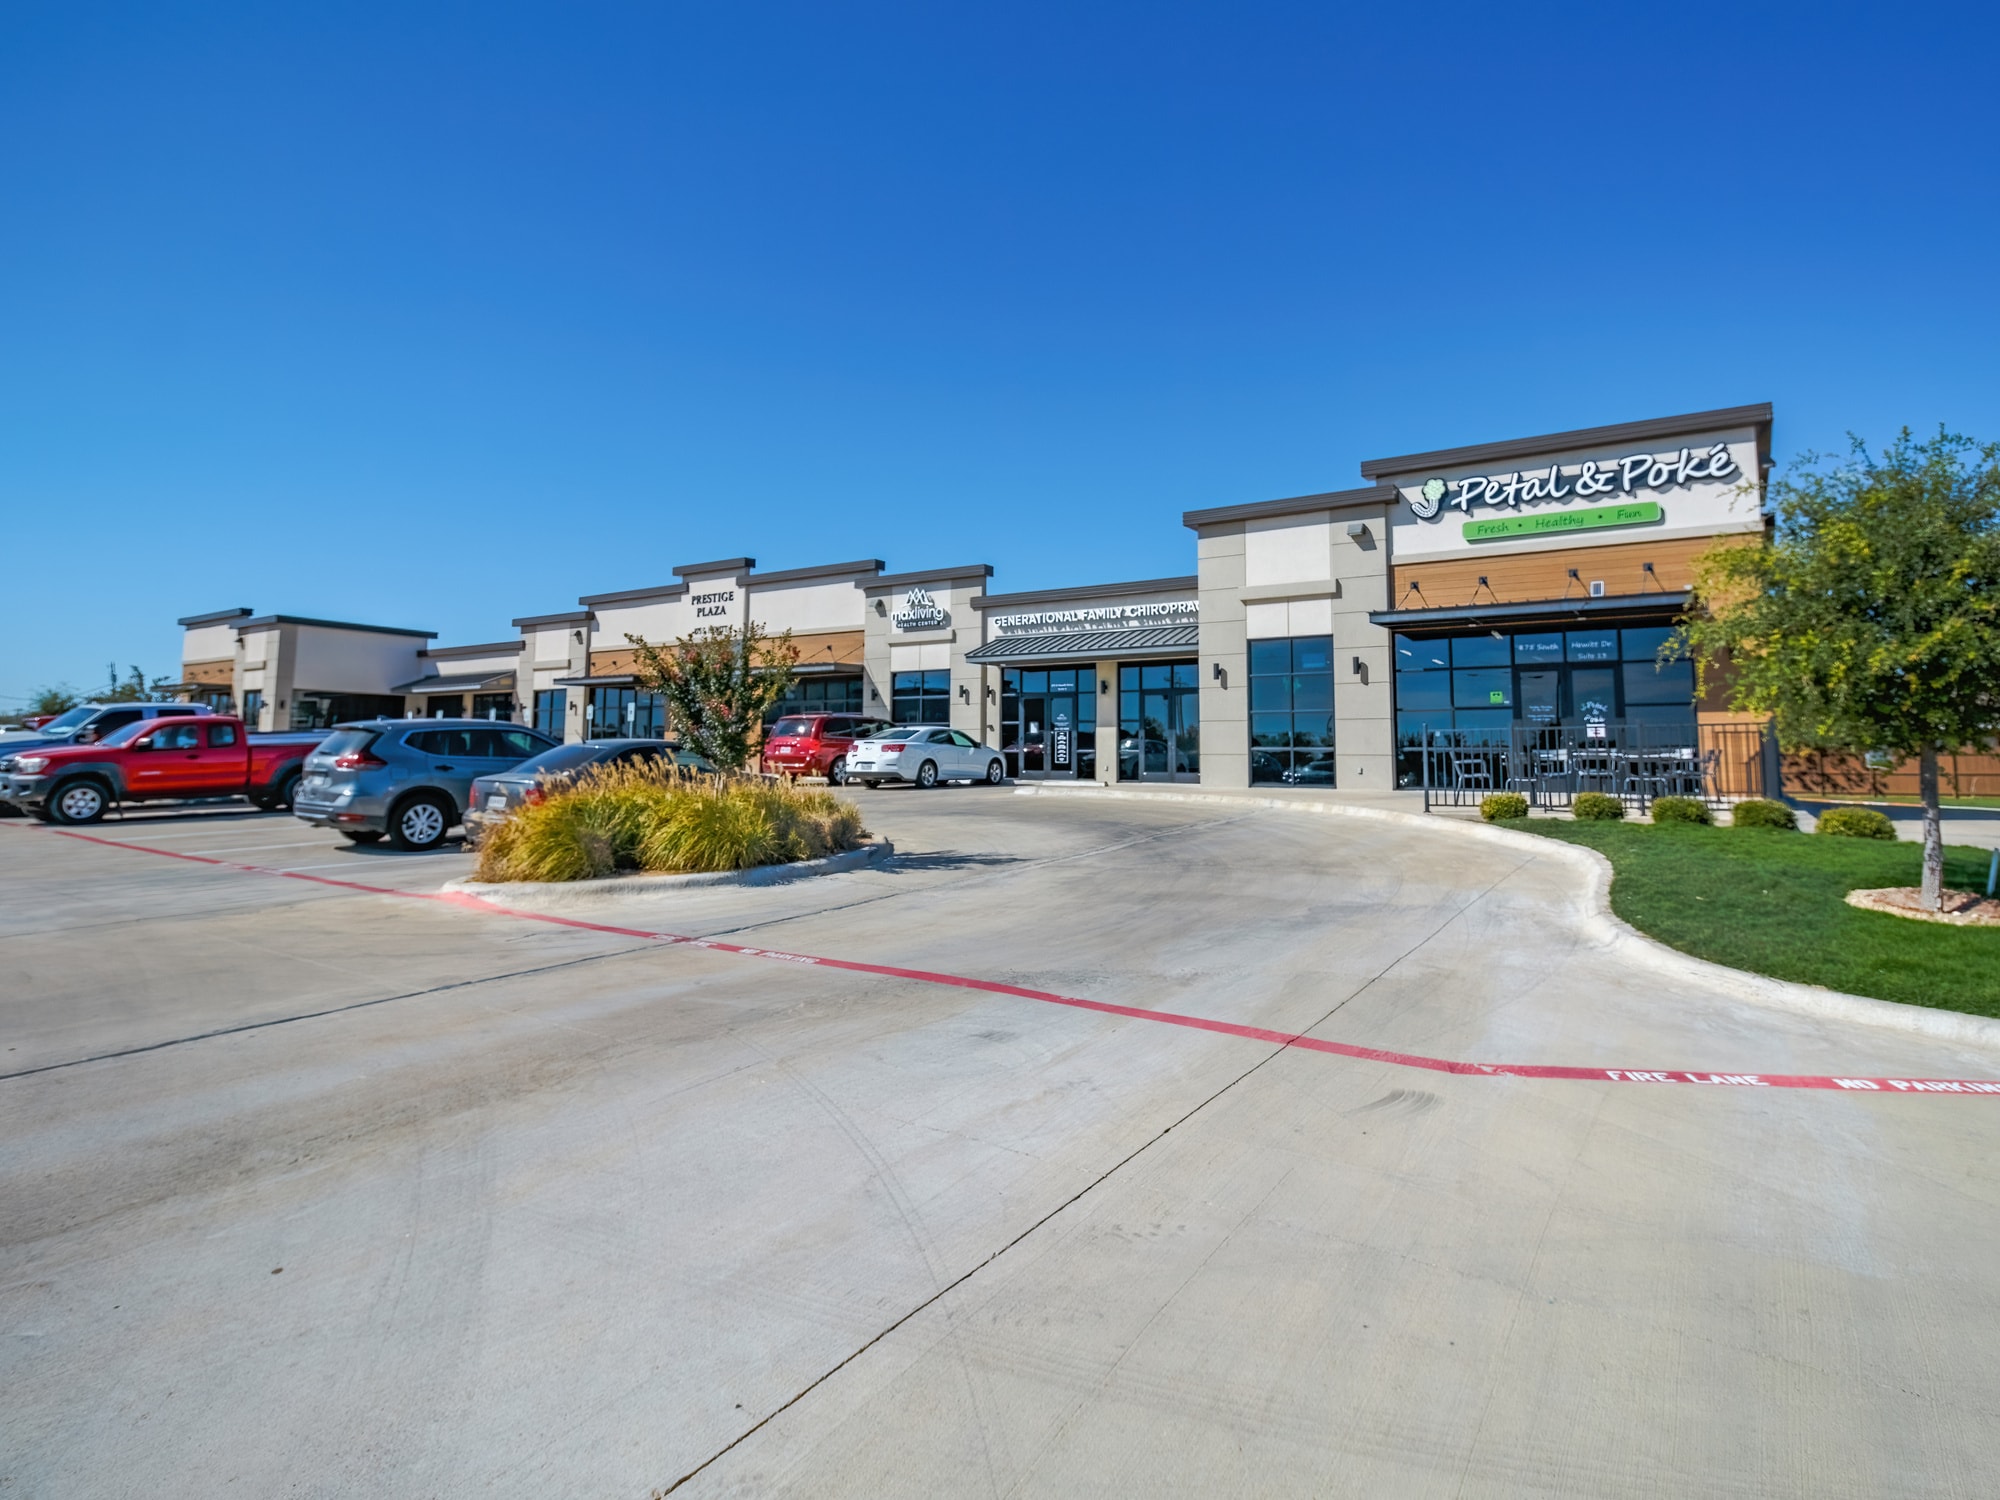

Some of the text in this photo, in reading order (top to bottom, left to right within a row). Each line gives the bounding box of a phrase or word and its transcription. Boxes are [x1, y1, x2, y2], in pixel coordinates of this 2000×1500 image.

[1451, 442, 1737, 512] Petal & Poké
[1477, 508, 1643, 535] Fresh Healthy Fun
[691, 591, 734, 605] PRESTIGE
[697, 605, 726, 617] PLAZA
[891, 605, 944, 621] maxliving
[993, 611, 1078, 627] GENERATIONAL
[1082, 606, 1124, 621] FAMILY
[1606, 1070, 1769, 1086] FIRE LANE
[1831, 1078, 2000, 1093] NO PARKIN
